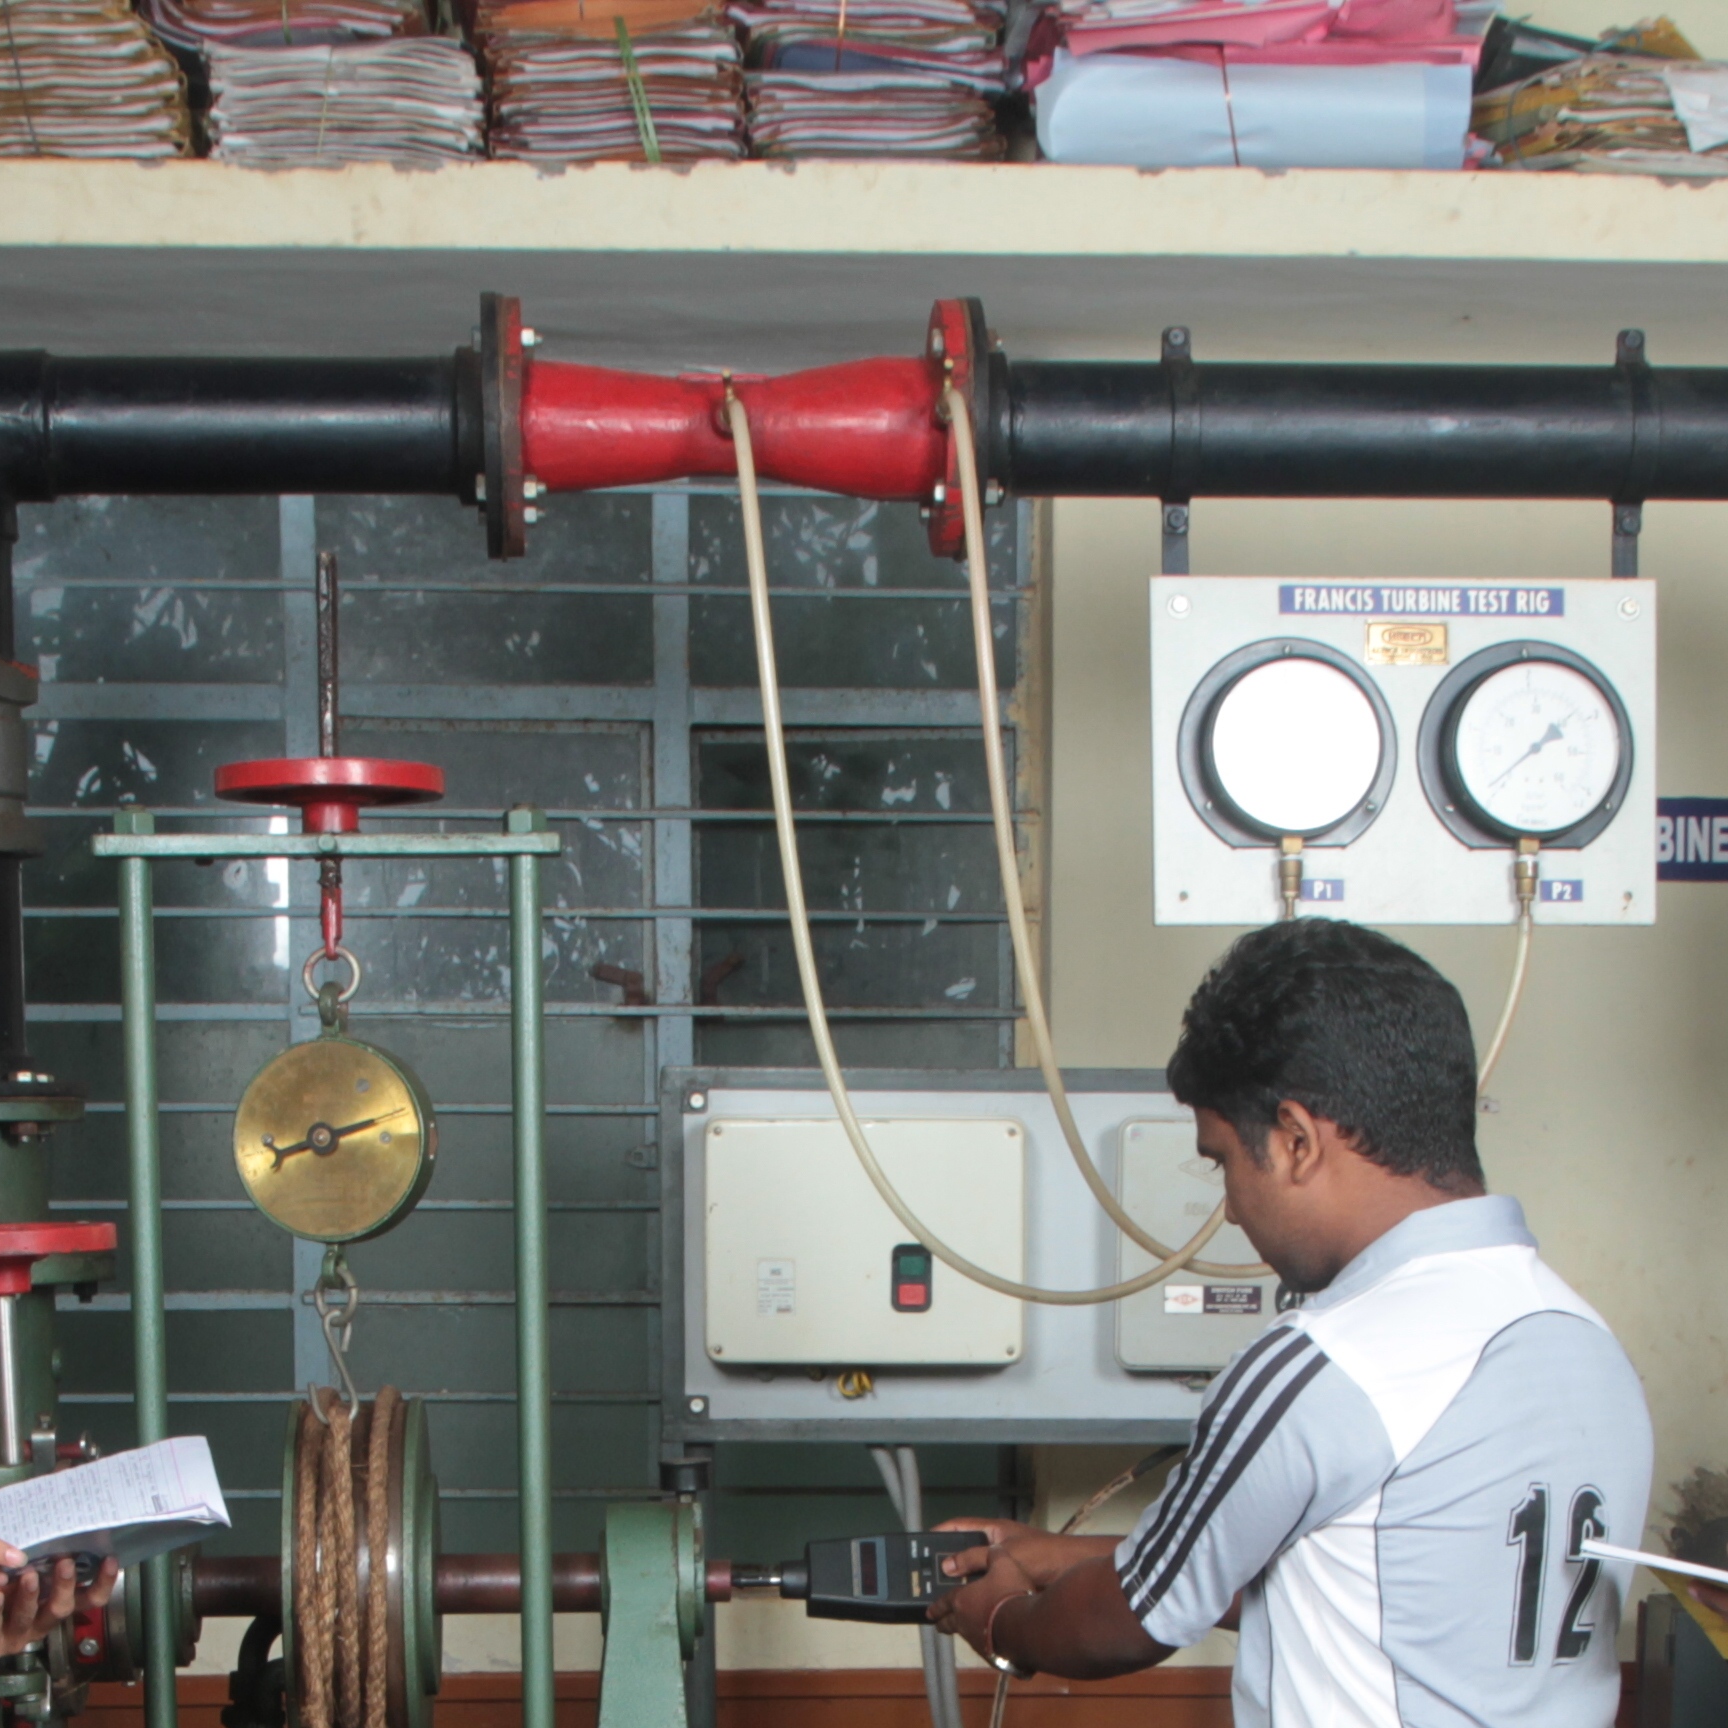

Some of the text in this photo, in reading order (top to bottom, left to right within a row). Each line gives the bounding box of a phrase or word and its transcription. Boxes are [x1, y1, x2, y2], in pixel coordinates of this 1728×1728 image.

[1294, 588, 1551, 614] FRANCIS TURBINE TEST RIG
[1313, 880, 1332, 899] P1
[1552, 881, 1572, 900] P2
[1506, 1482, 1610, 1668] 12
